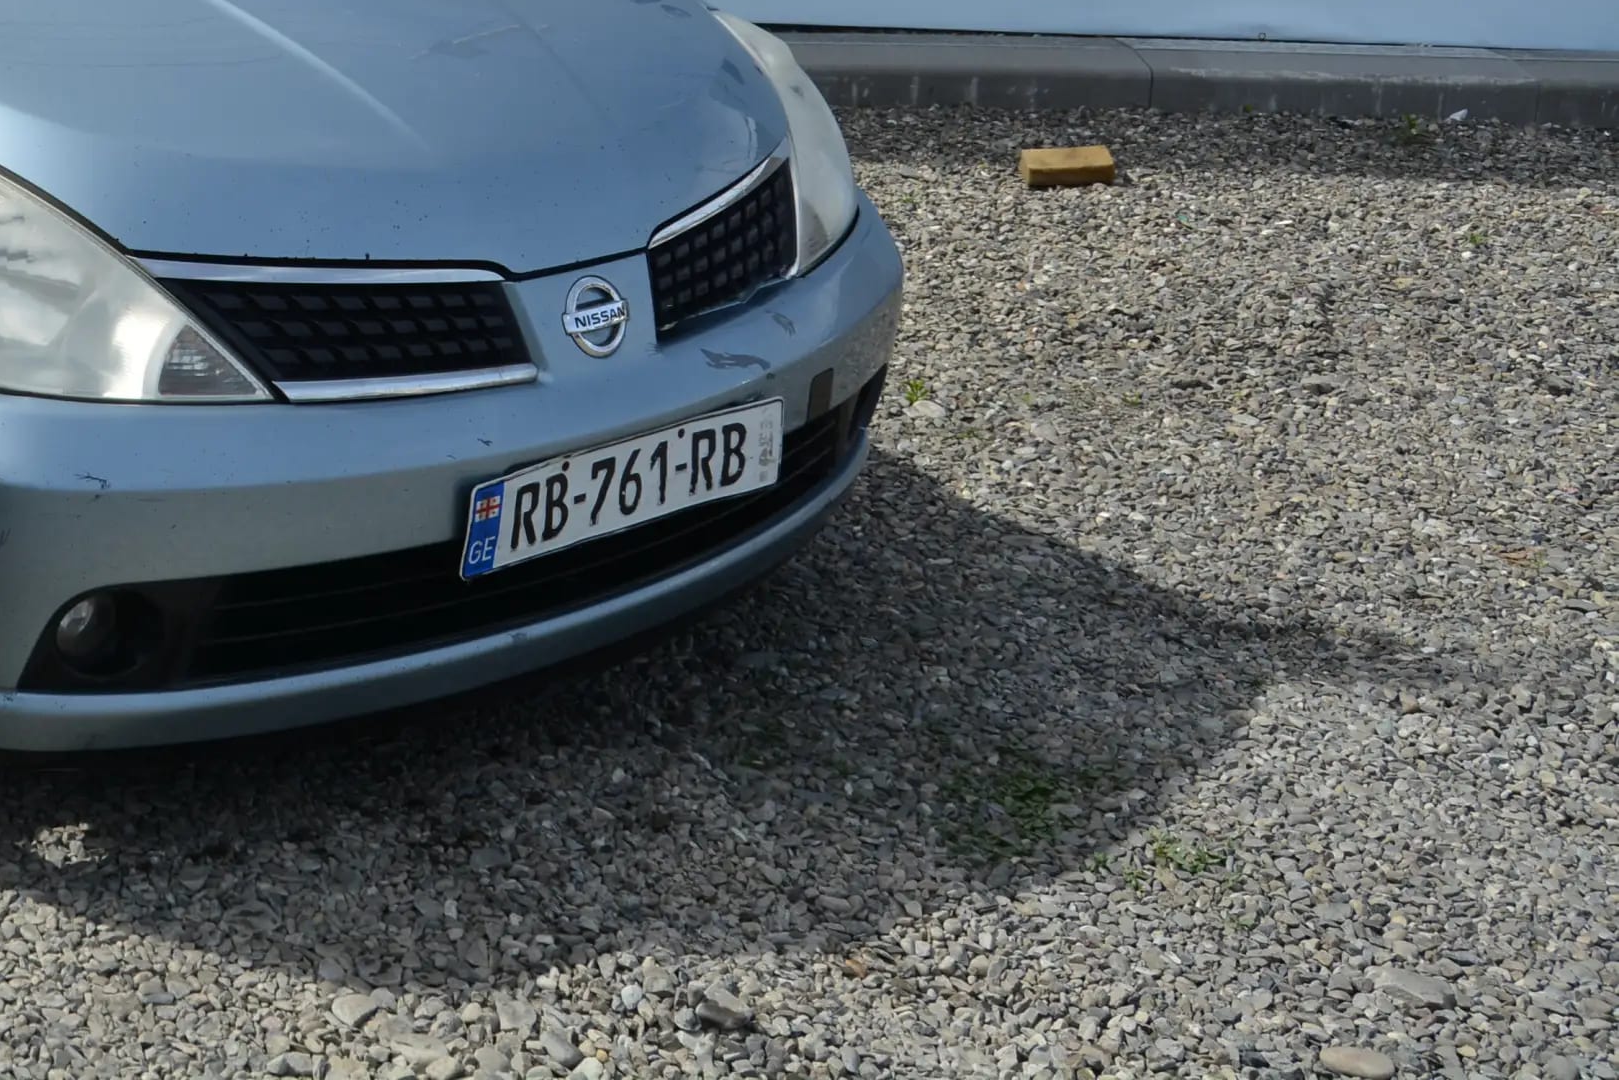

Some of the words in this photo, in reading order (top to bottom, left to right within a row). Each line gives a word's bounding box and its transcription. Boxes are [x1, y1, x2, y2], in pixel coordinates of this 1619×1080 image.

[574, 306, 626, 329] NISSAN
[509, 422, 747, 552] RB-761-RB
[468, 536, 496, 566] GE
